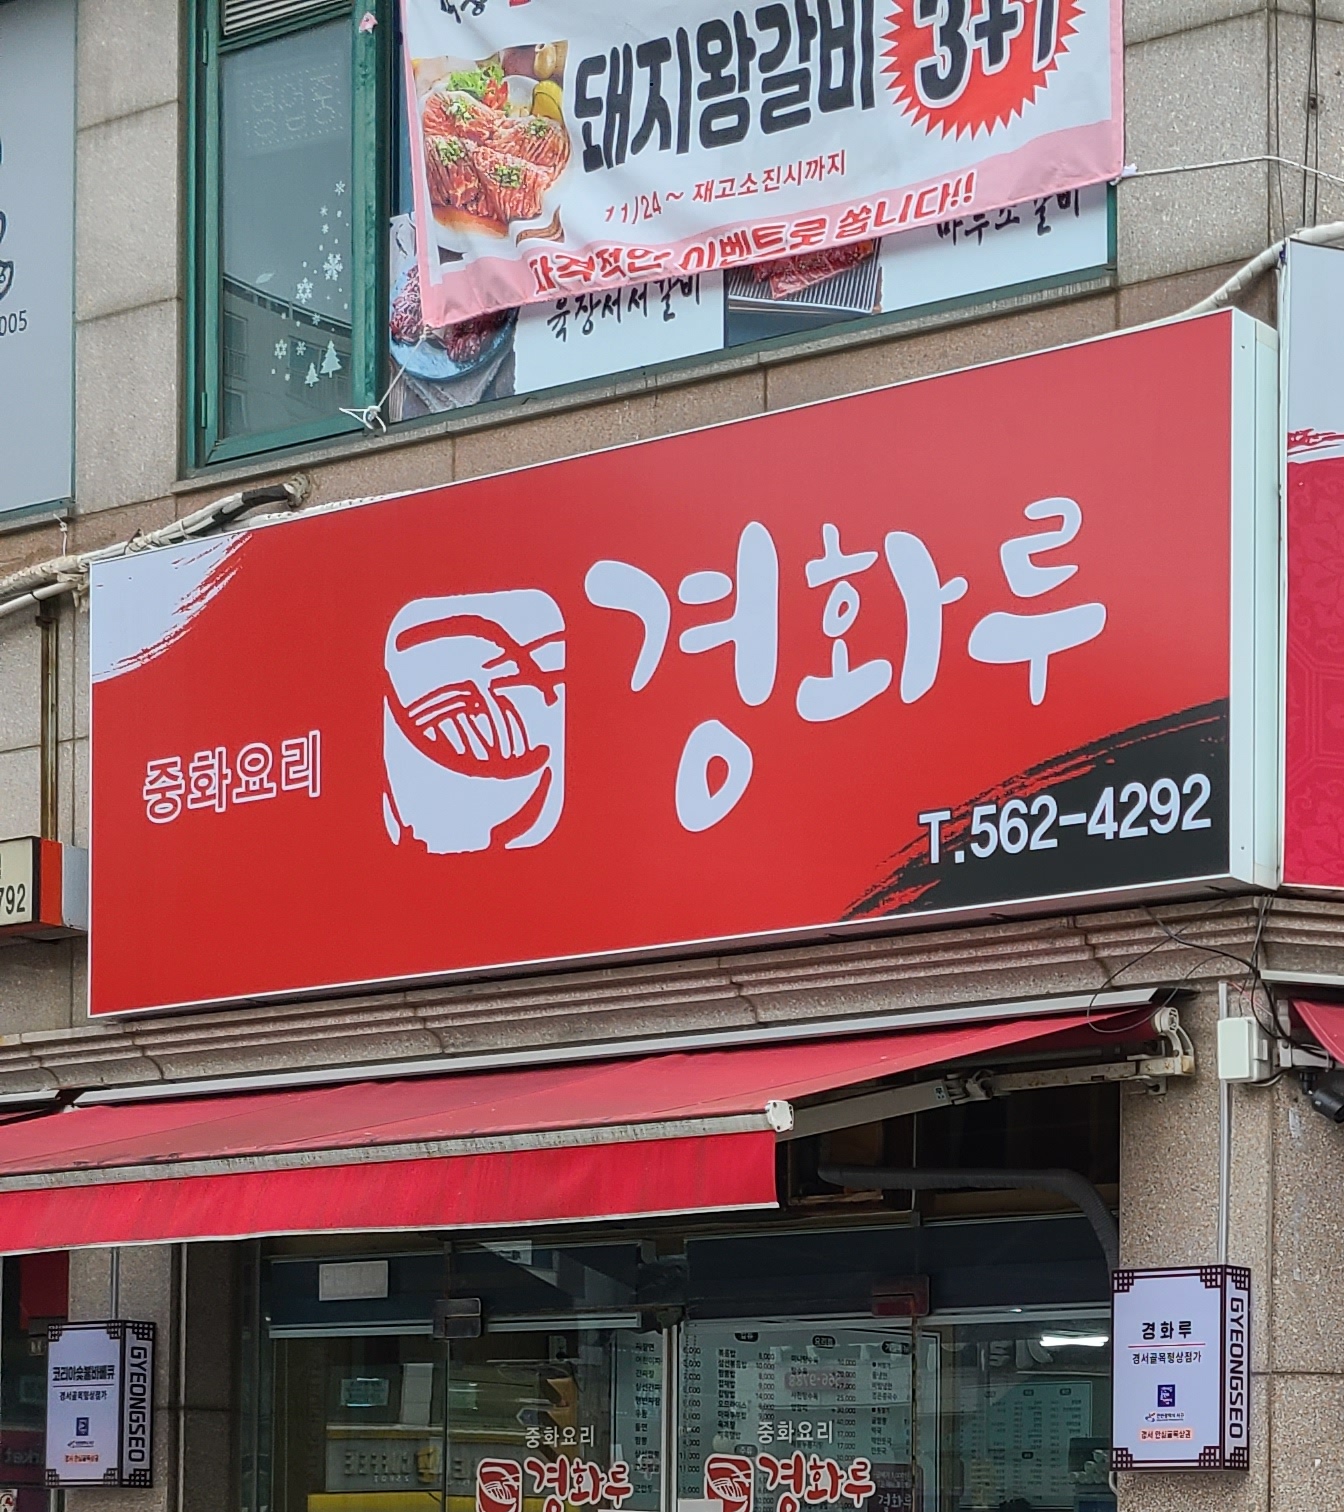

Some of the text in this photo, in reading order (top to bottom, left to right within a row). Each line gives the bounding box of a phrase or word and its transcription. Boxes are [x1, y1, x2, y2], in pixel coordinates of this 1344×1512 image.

[574, 0, 1060, 173] 돼지왕갈비 3+1
[679, 217, 828, 271] 이벤트로
[837, 171, 976, 240] 쏩니다!!
[691, 149, 846, 204] 재고소진시까지
[585, 497, 1107, 832] 경화루
[142, 730, 322, 824] 중화요리
[919, 772, 1213, 865] T.562-4292
[1132, 1351, 1202, 1364] 경서골목형상점가
[1141, 1320, 1192, 1341] 경화루
[1229, 1297, 1244, 1439] GYEONGSEO
[128, 1346, 148, 1463] GYEONGSEO
[525, 1425, 594, 1448] 중화요리
[757, 1420, 834, 1444] 중화요리
